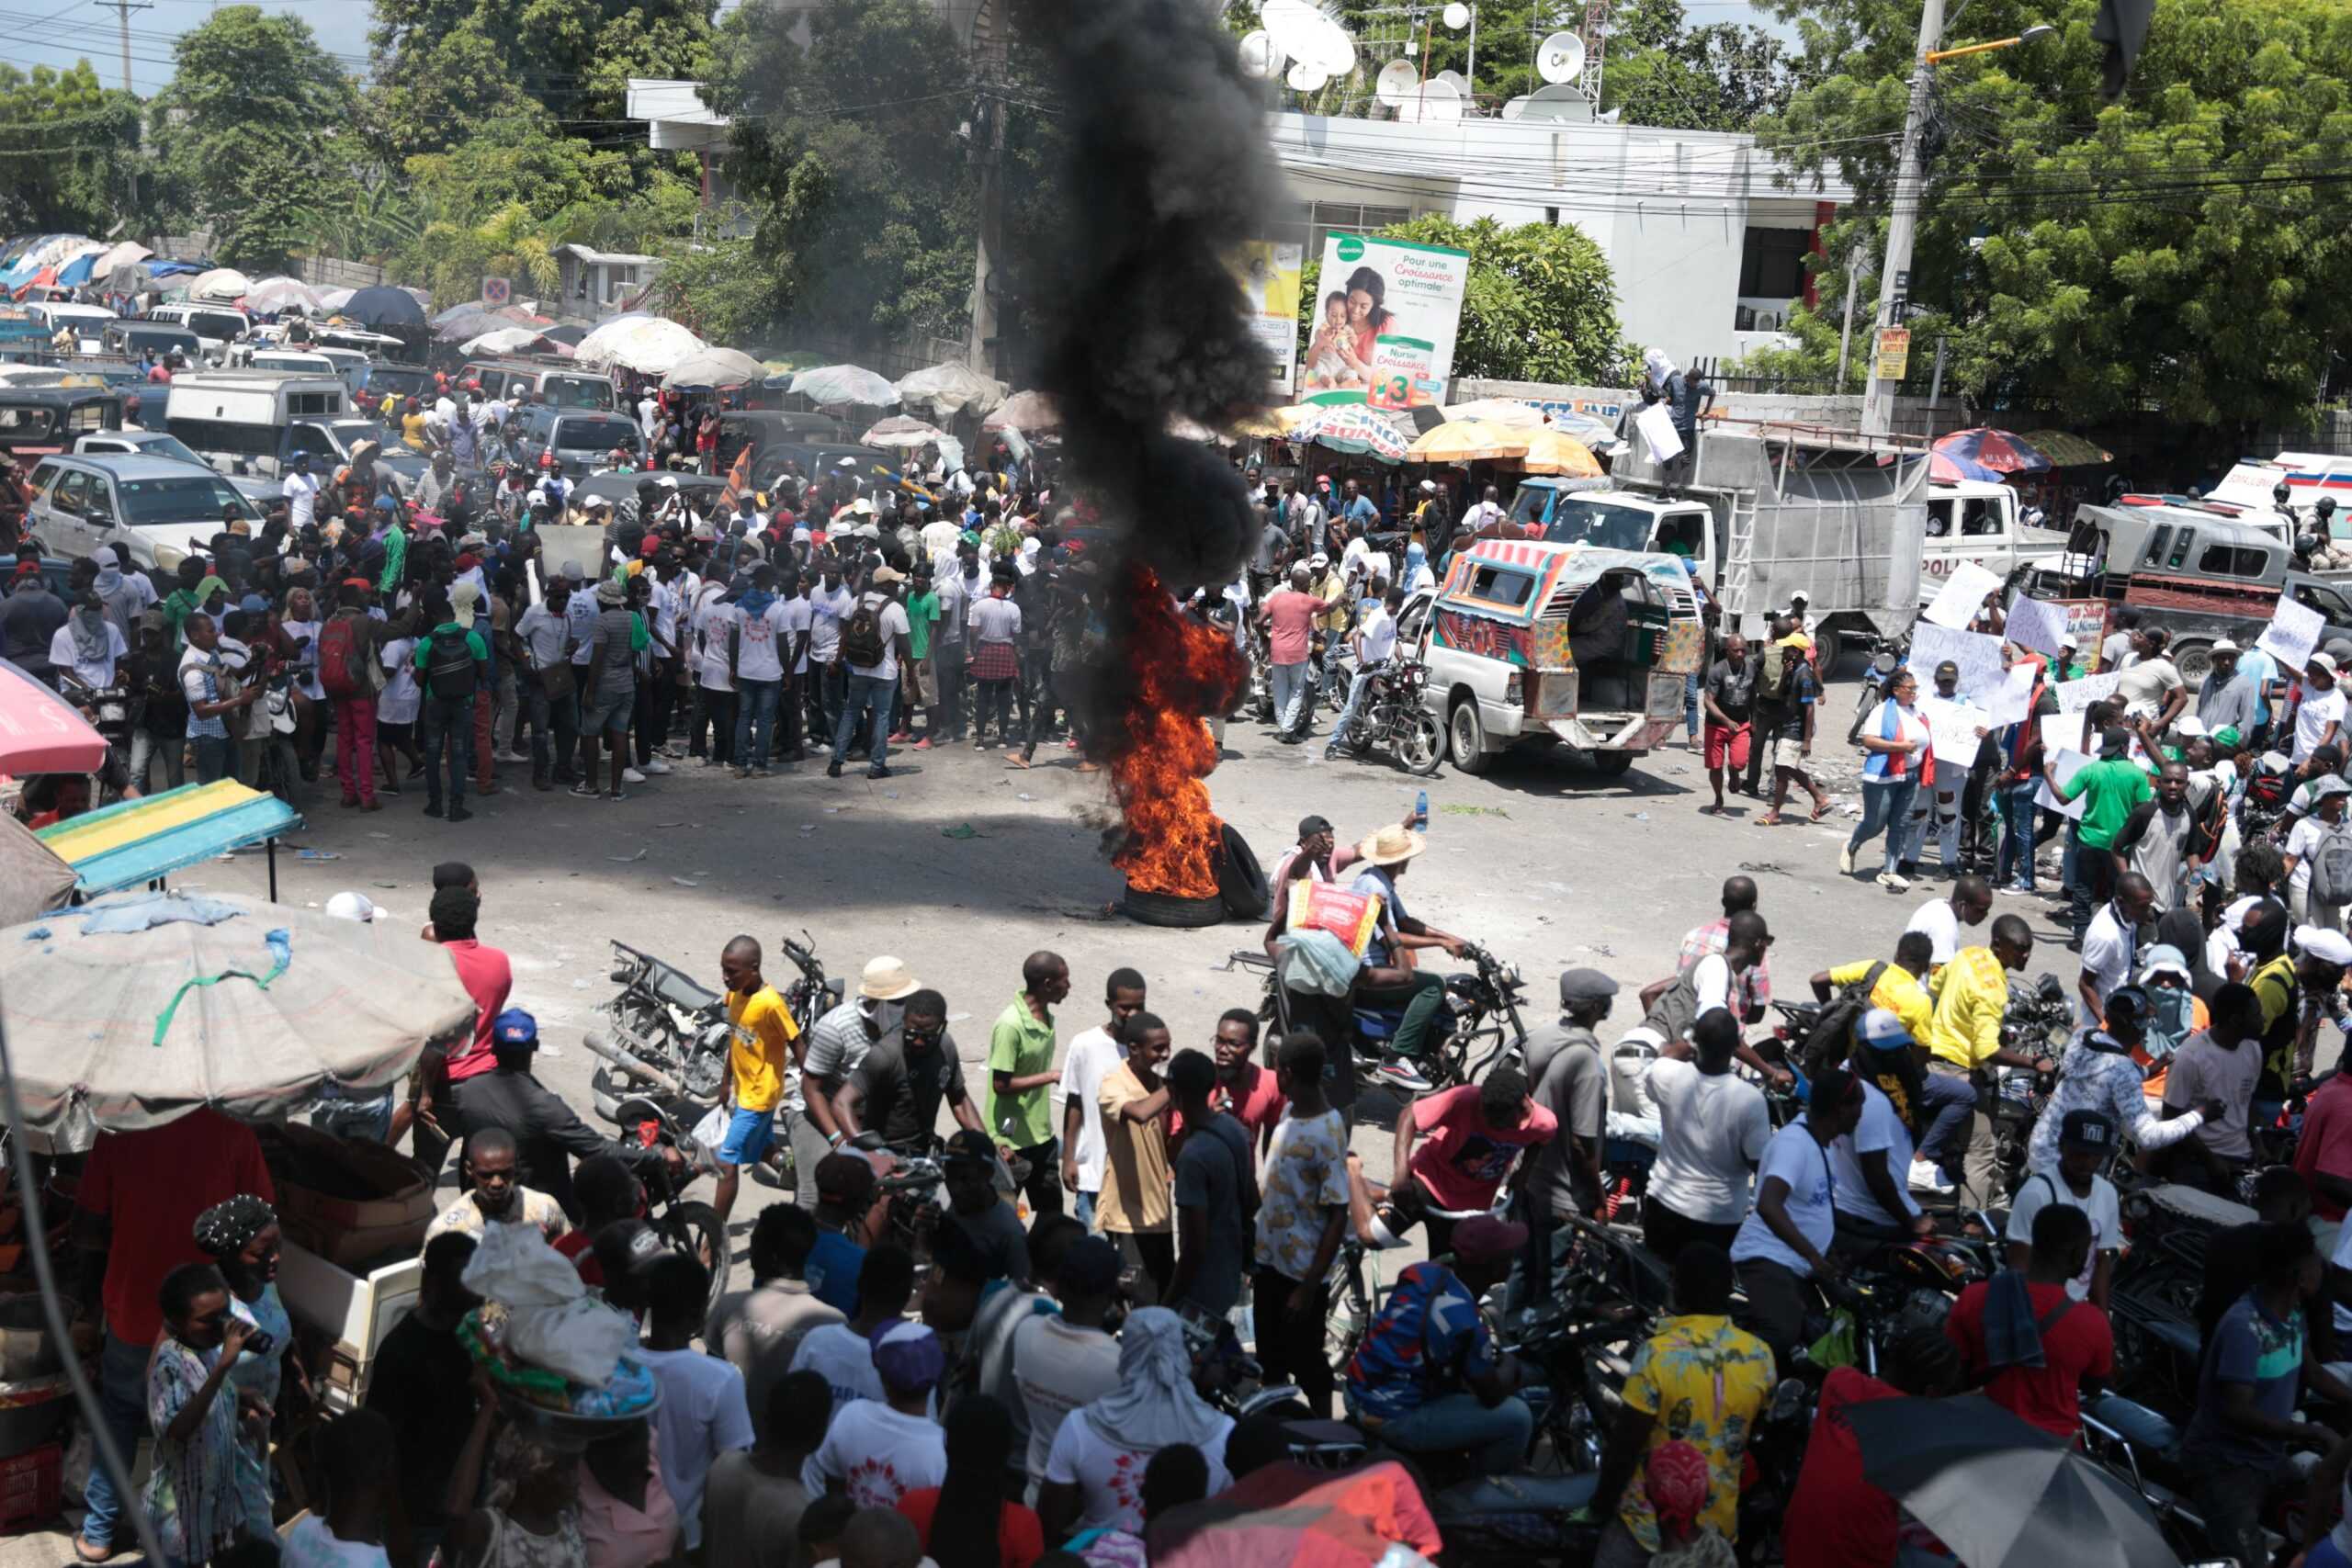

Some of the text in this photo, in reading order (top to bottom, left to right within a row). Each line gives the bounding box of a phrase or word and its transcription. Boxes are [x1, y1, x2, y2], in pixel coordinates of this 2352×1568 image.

[1403, 255, 1447, 270] Pour une
[1395, 264, 1453, 282] Croissance
[1390, 375, 1408, 402] 3
[1921, 558, 1984, 575] POLIE
